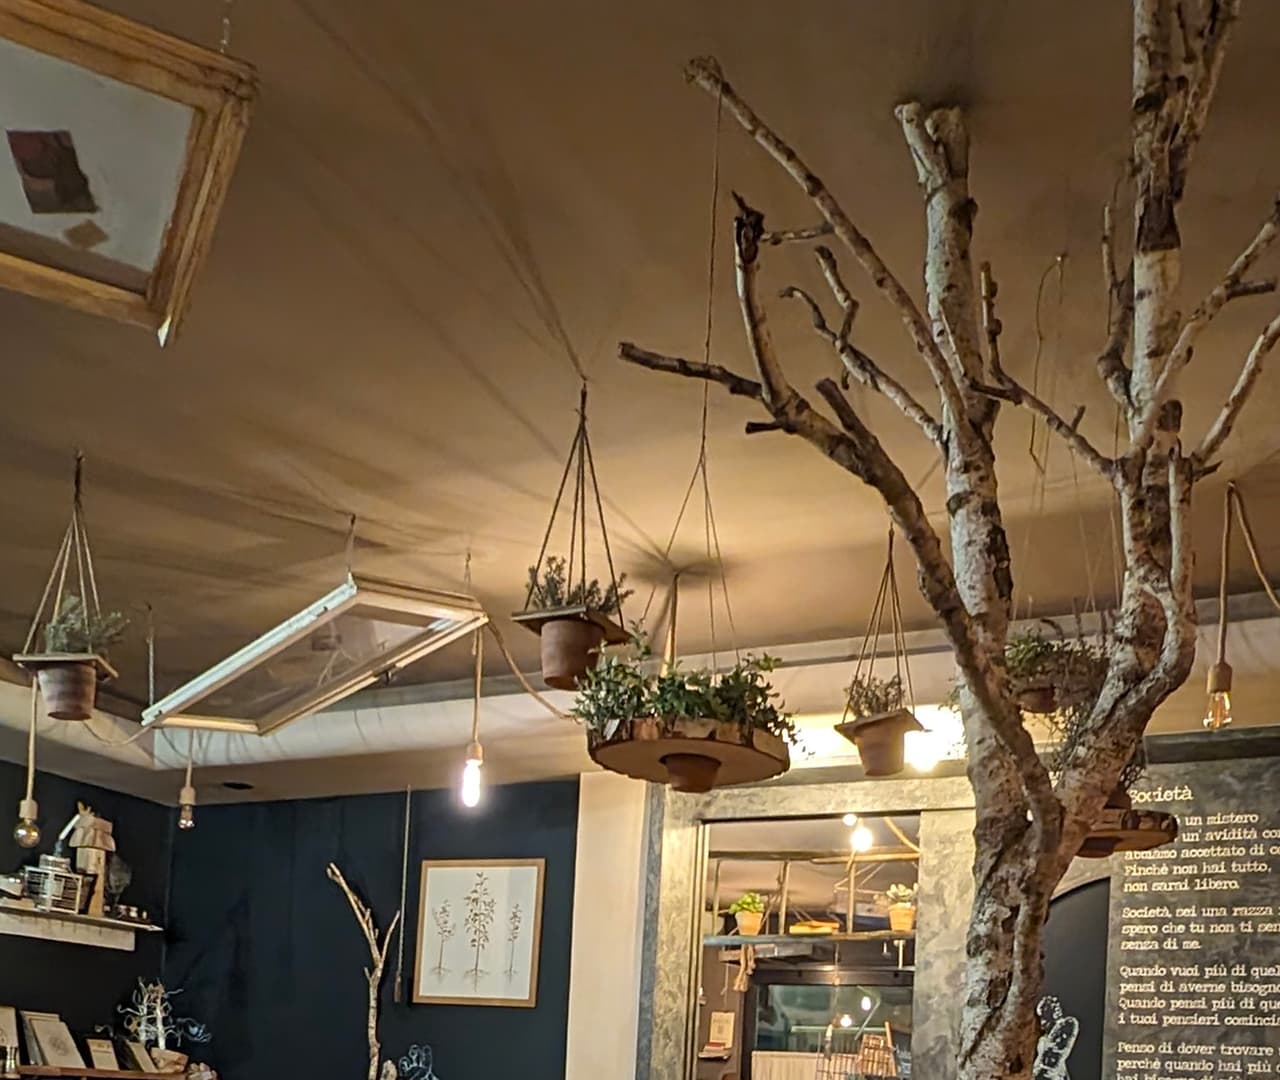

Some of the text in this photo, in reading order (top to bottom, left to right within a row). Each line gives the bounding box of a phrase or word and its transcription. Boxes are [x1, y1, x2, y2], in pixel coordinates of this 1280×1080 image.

[1128, 785, 1194, 803] Società
[1185, 813, 1259, 825] un mistero
[1205, 828, 1257, 841] avidità
[1181, 846, 1245, 858] accettato
[1250, 844, 1265, 855] di
[1173, 865, 1197, 874] non
[1202, 862, 1226, 873] hai
[1124, 883, 1148, 892] non
[1152, 879, 1190, 891] sarai
[1176, 907, 1197, 917] sei
[1202, 908, 1227, 917] una
[1233, 907, 1273, 916] razza
[1122, 924, 1158, 937] spero
[1162, 922, 1185, 933] che
[1190, 923, 1205, 933] tu
[1210, 924, 1235, 933] non
[1240, 921, 1253, 932] ti
[1121, 941, 1159, 950] senza
[1163, 938, 1178, 949] di
[1120, 964, 1167, 978] Quando
[1170, 965, 1199, 976] vuoi
[1205, 964, 1227, 978] più
[1231, 965, 1246, 976] di
[1120, 981, 1155, 994] pensi
[1160, 981, 1175, 992] di
[1179, 983, 1226, 992] averne
[1119, 997, 1166, 1010] Quando
[1170, 998, 1207, 1011] pensi
[1212, 997, 1235, 1011] più
[1240, 998, 1255, 1009] di
[1118, 1014, 1125, 1024] i
[1130, 1013, 1158, 1024] tuoi
[1162, 1014, 1220, 1027] pensieri
[1118, 1042, 1155, 1053] Penso
[1158, 1042, 1173, 1053] di
[1177, 1042, 1216, 1054] dover
[1220, 1044, 1273, 1056] trovare
[1165, 1060, 1214, 1072] quando
[1218, 1060, 1242, 1072] hai
[1248, 1060, 1271, 1074] più
